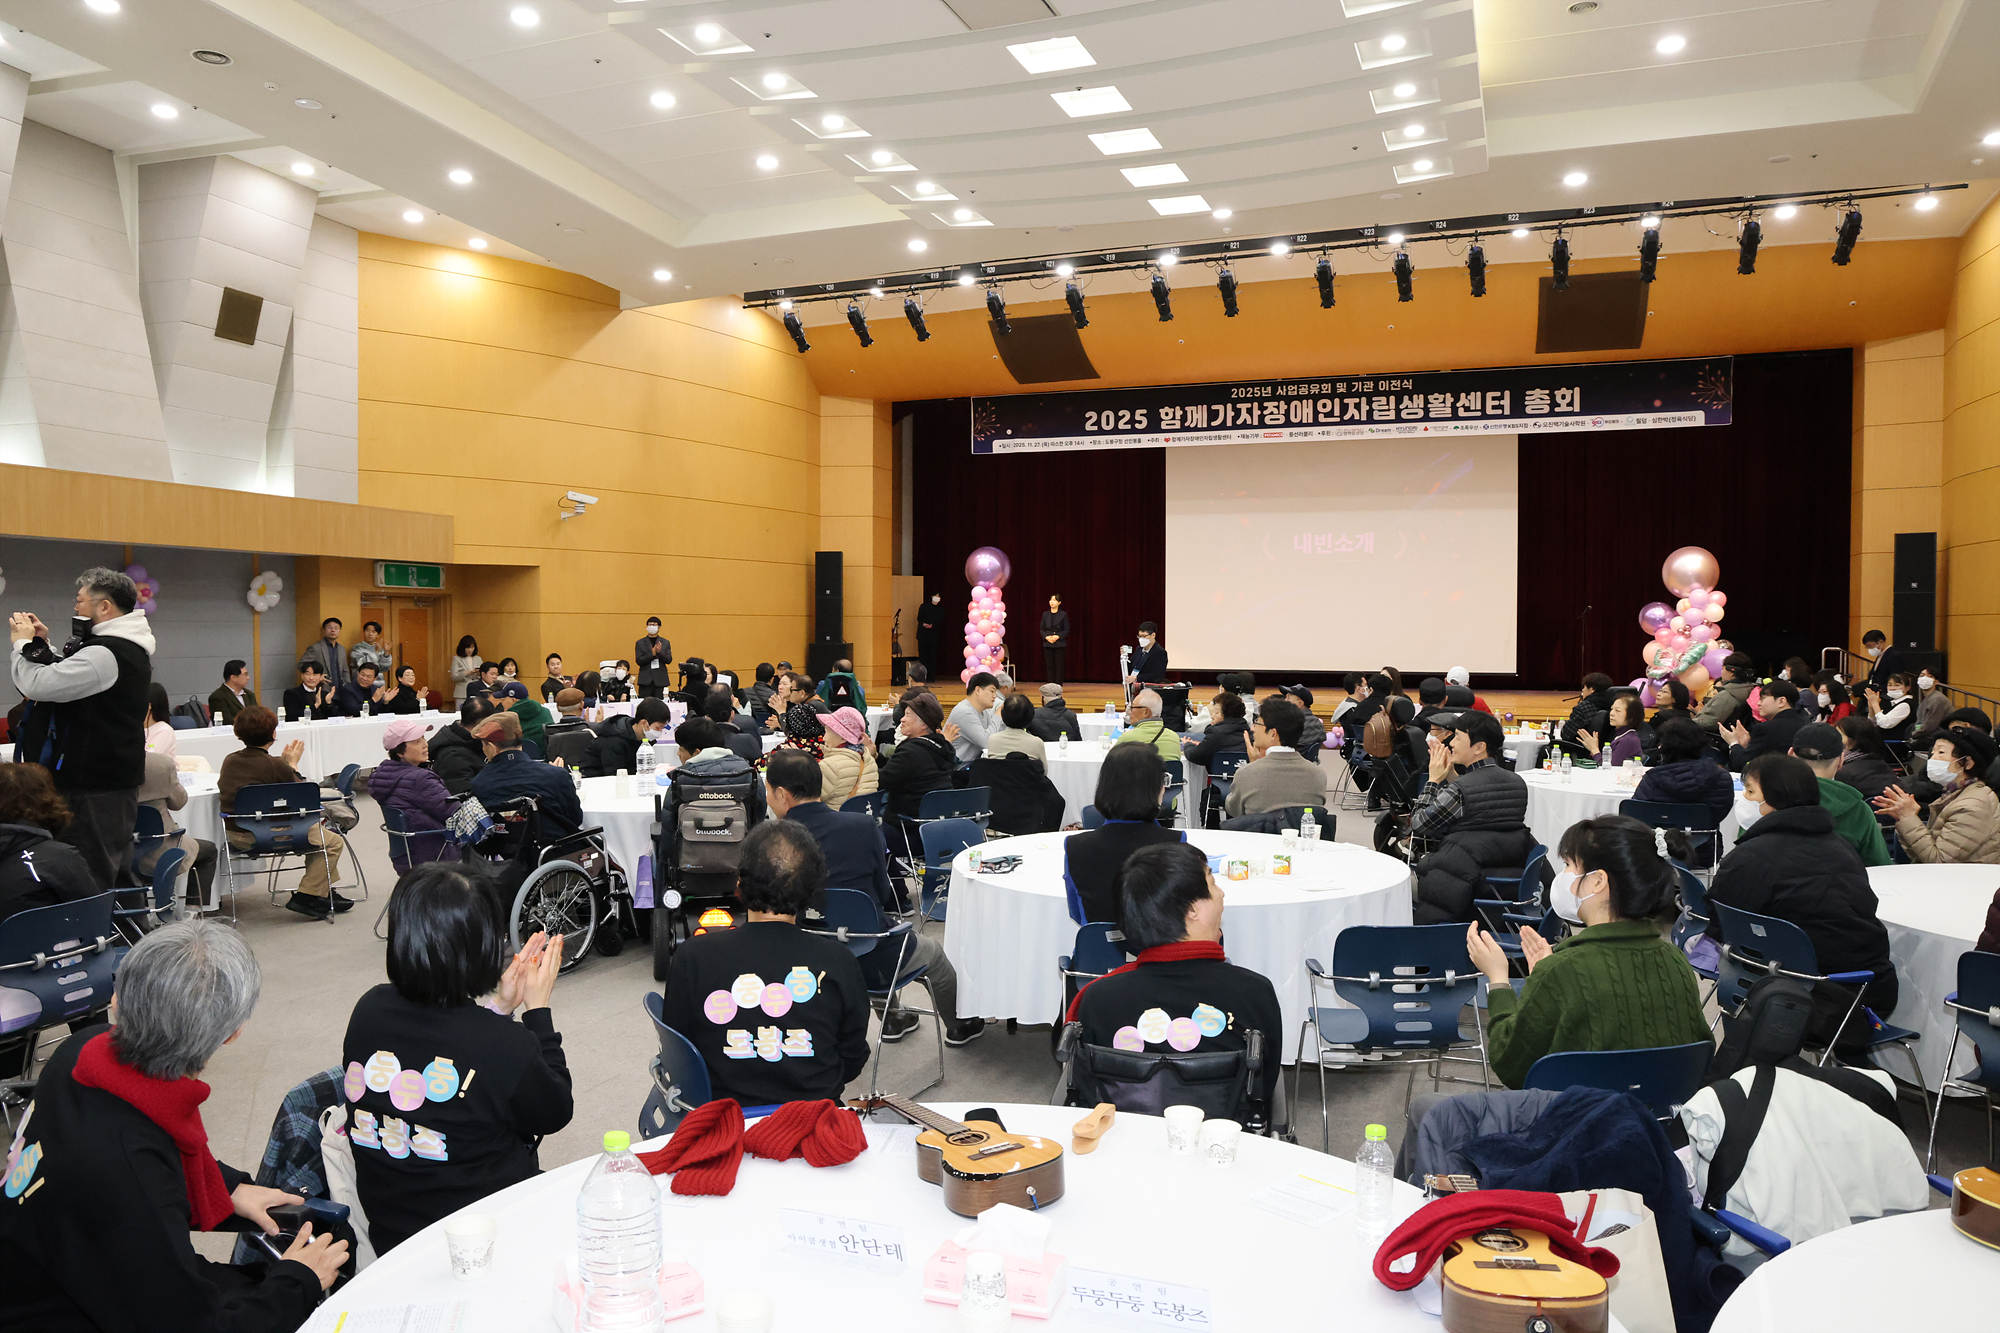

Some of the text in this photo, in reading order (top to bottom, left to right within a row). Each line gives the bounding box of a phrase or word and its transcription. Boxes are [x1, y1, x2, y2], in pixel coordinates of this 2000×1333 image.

[1435, 221, 1447, 229] R24
[1508, 213, 1520, 221] R22
[1364, 228, 1375, 236] R23
[1231, 379, 1413, 398] 2025년 사업공유회 및 기관 이전식
[1084, 386, 1581, 431] 2025 함께가자장애인자립생활센터 총회
[1293, 532, 1374, 554] 내빈소개
[723, 1025, 815, 1062] 도봉즈
[350, 1108, 448, 1161] 도봉즈
[838, 1233, 903, 1262] 안단테
[1071, 1286, 1208, 1323] 두둥두둥 도봉즈
